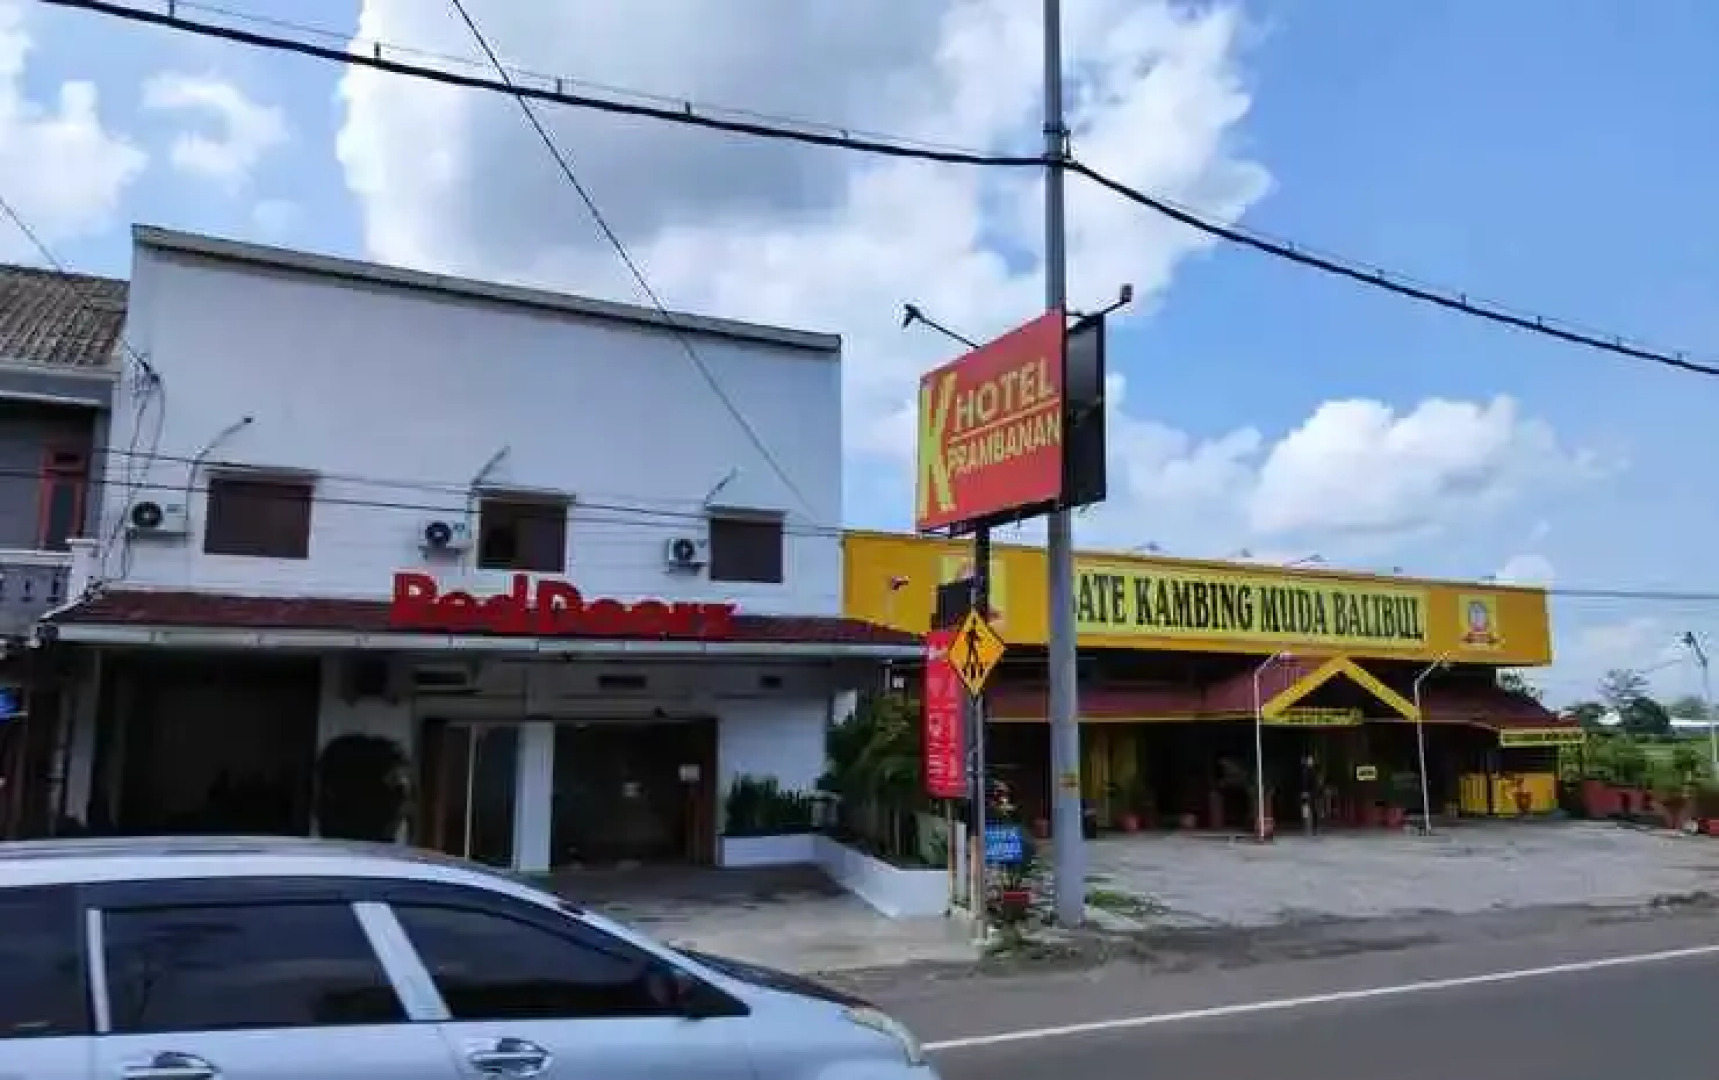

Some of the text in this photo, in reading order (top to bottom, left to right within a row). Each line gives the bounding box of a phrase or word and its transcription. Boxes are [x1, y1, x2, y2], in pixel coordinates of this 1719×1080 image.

[956, 357, 1054, 434] HOTEL
[919, 372, 957, 520] K
[947, 411, 1061, 477] PRAMBANAN
[1073, 573, 1425, 640] ATE KAMBING MUDA BALIBUL
